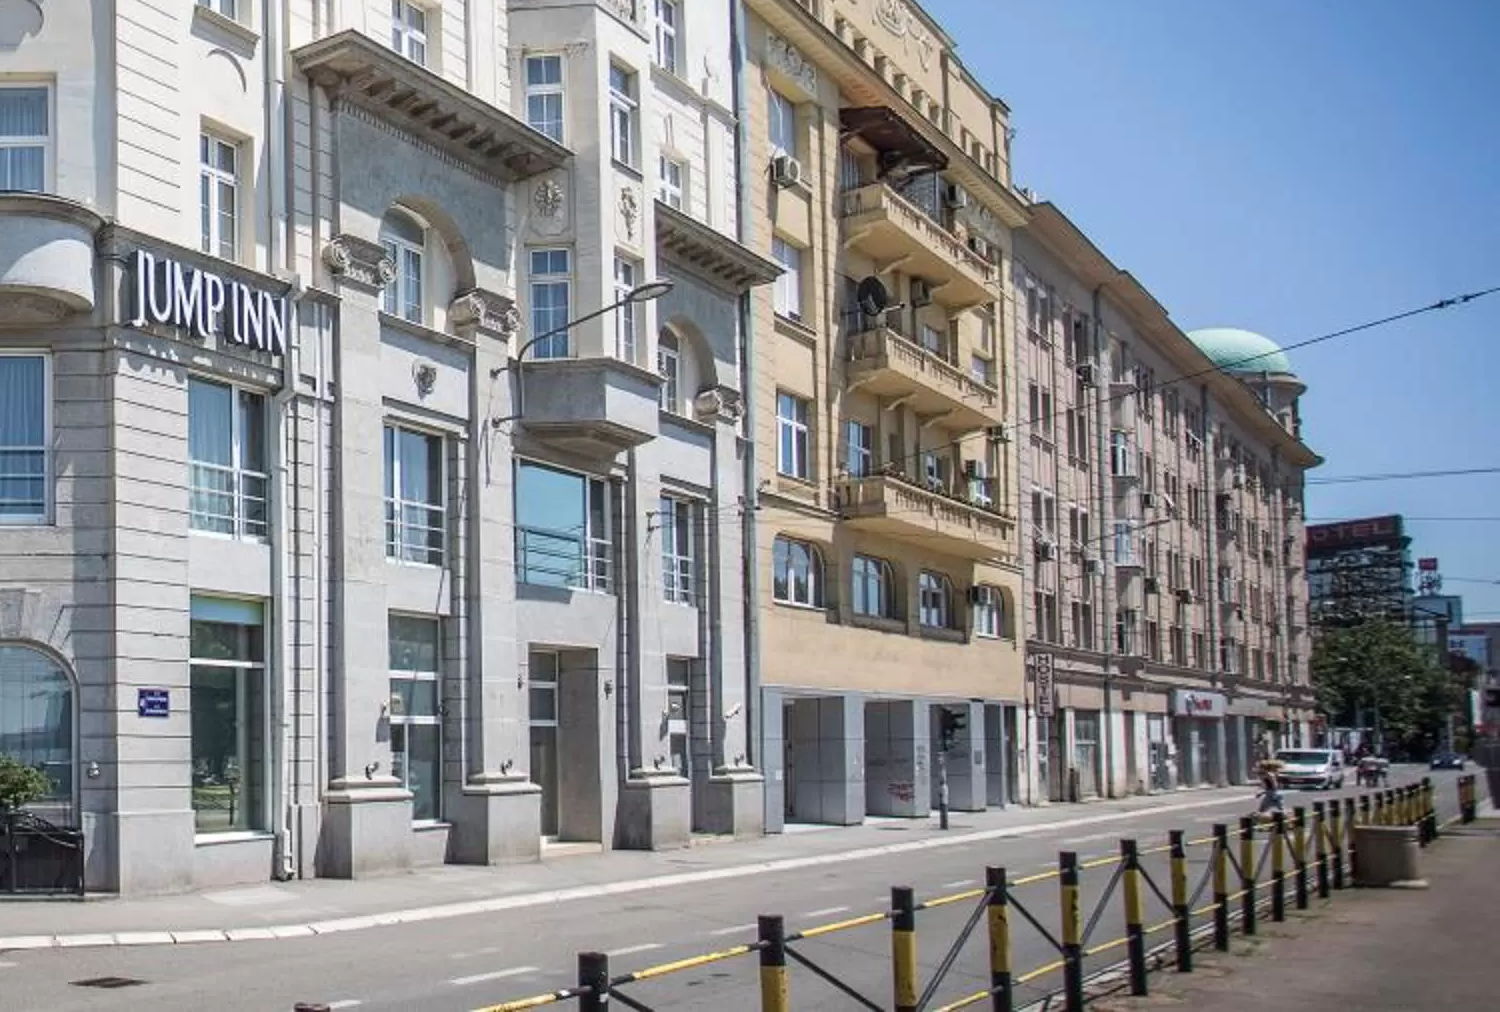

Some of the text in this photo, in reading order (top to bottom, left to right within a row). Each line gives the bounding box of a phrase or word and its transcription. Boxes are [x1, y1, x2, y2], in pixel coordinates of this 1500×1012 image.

[132, 249, 287, 355] JUMP INN
[1037, 655, 1051, 715] HOSTEL
